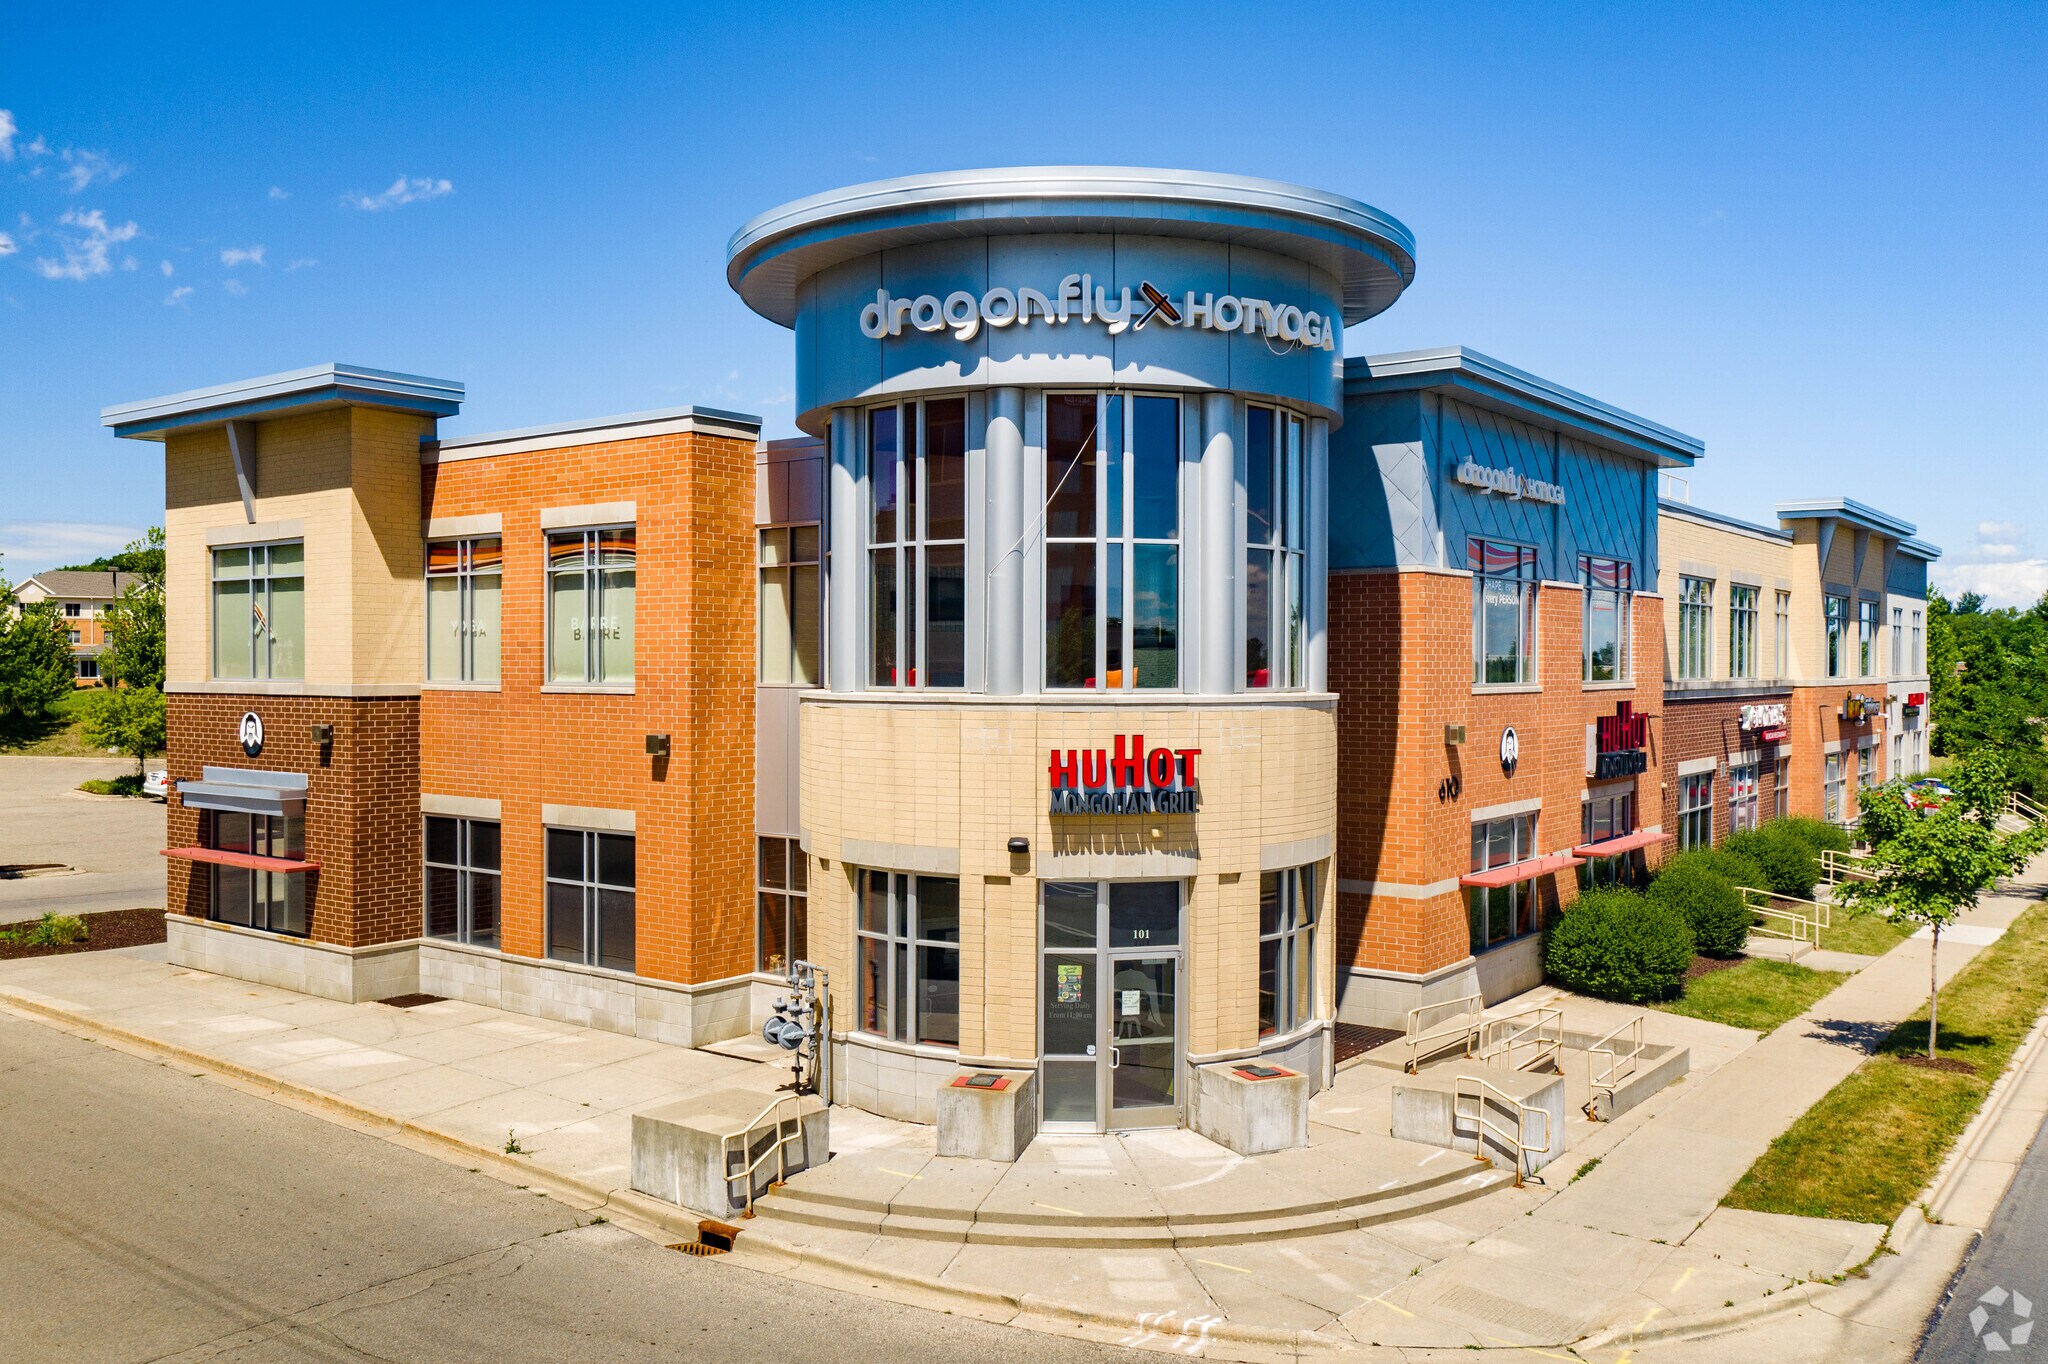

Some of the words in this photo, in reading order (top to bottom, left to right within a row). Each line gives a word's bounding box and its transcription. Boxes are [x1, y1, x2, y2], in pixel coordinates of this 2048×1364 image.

[860, 273, 1133, 341] dragonfly
[1457, 455, 1522, 500] dragonfly
[1439, 776, 1459, 805] 610
[1132, 929, 1150, 940] 101
[1048, 1011, 1065, 1019] From
[1050, 1002, 1074, 1010] Serving
